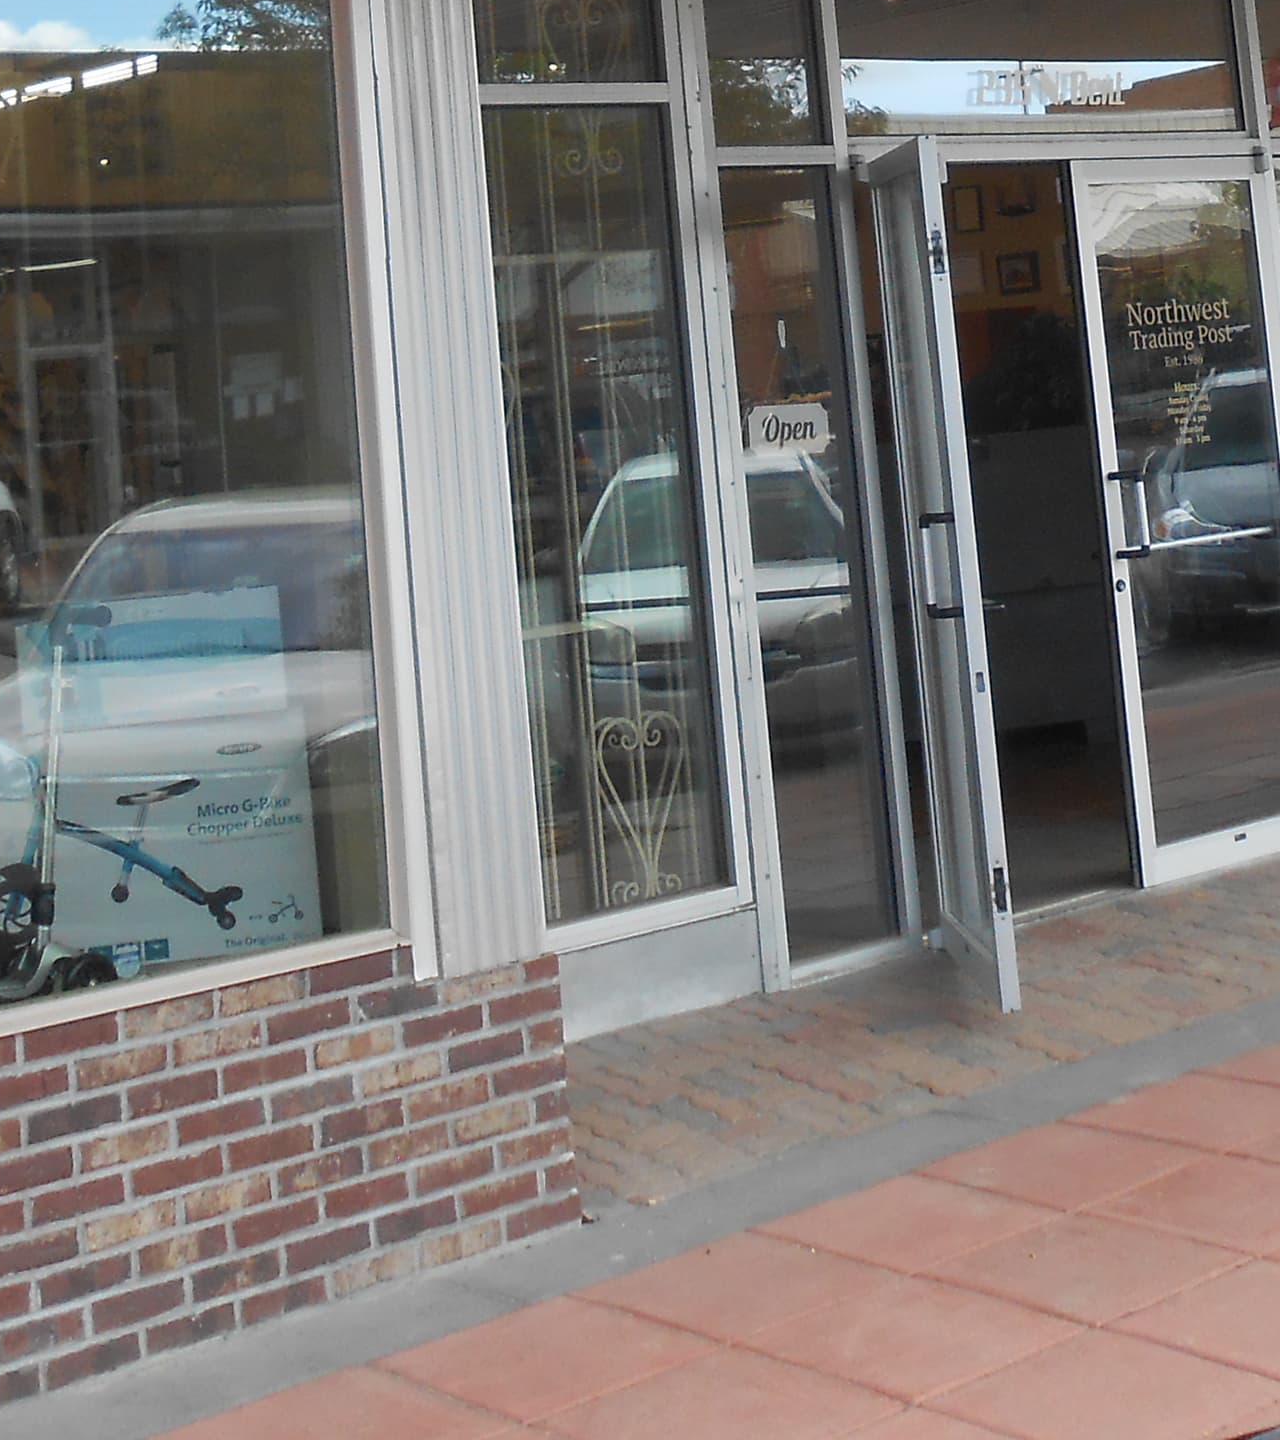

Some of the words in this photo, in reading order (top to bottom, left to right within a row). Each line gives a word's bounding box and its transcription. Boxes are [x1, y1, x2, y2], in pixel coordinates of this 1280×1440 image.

[1125, 298, 1231, 327] Northwest
[1128, 327, 1195, 350] Trading
[1197, 324, 1233, 344] Post
[762, 414, 817, 450] Open
[197, 802, 239, 817] Micro
[187, 820, 248, 837] Chopper
[252, 814, 304, 829] Deluxe
